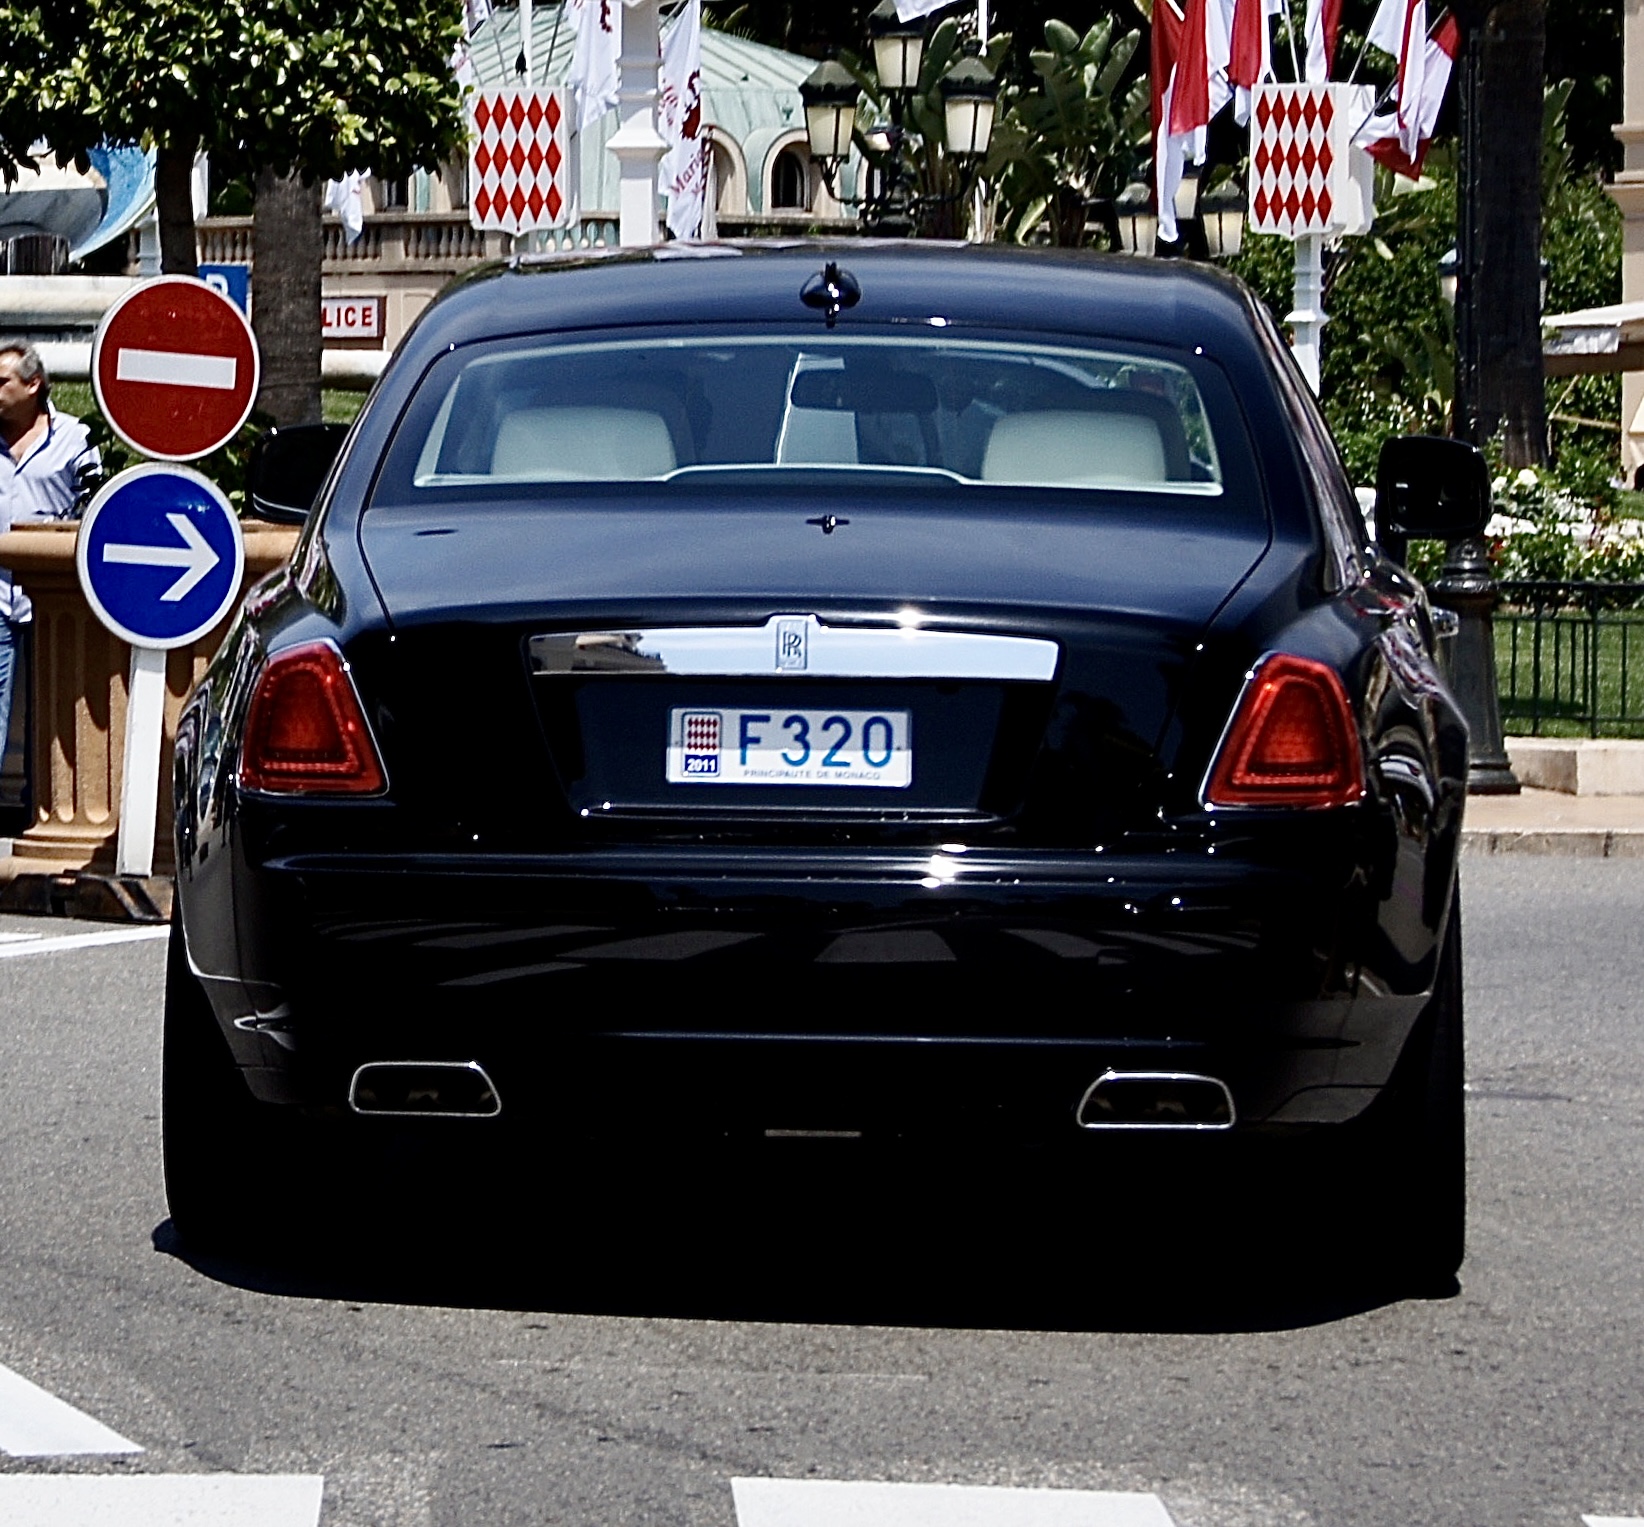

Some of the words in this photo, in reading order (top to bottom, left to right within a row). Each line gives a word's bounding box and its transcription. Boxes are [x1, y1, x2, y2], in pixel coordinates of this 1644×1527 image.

[739, 714, 893, 768] F320
[687, 758, 716, 772] 2011
[743, 769, 811, 778] PRINCIPAUTE
[816, 770, 829, 779] DE
[834, 771, 881, 780] MONACO
